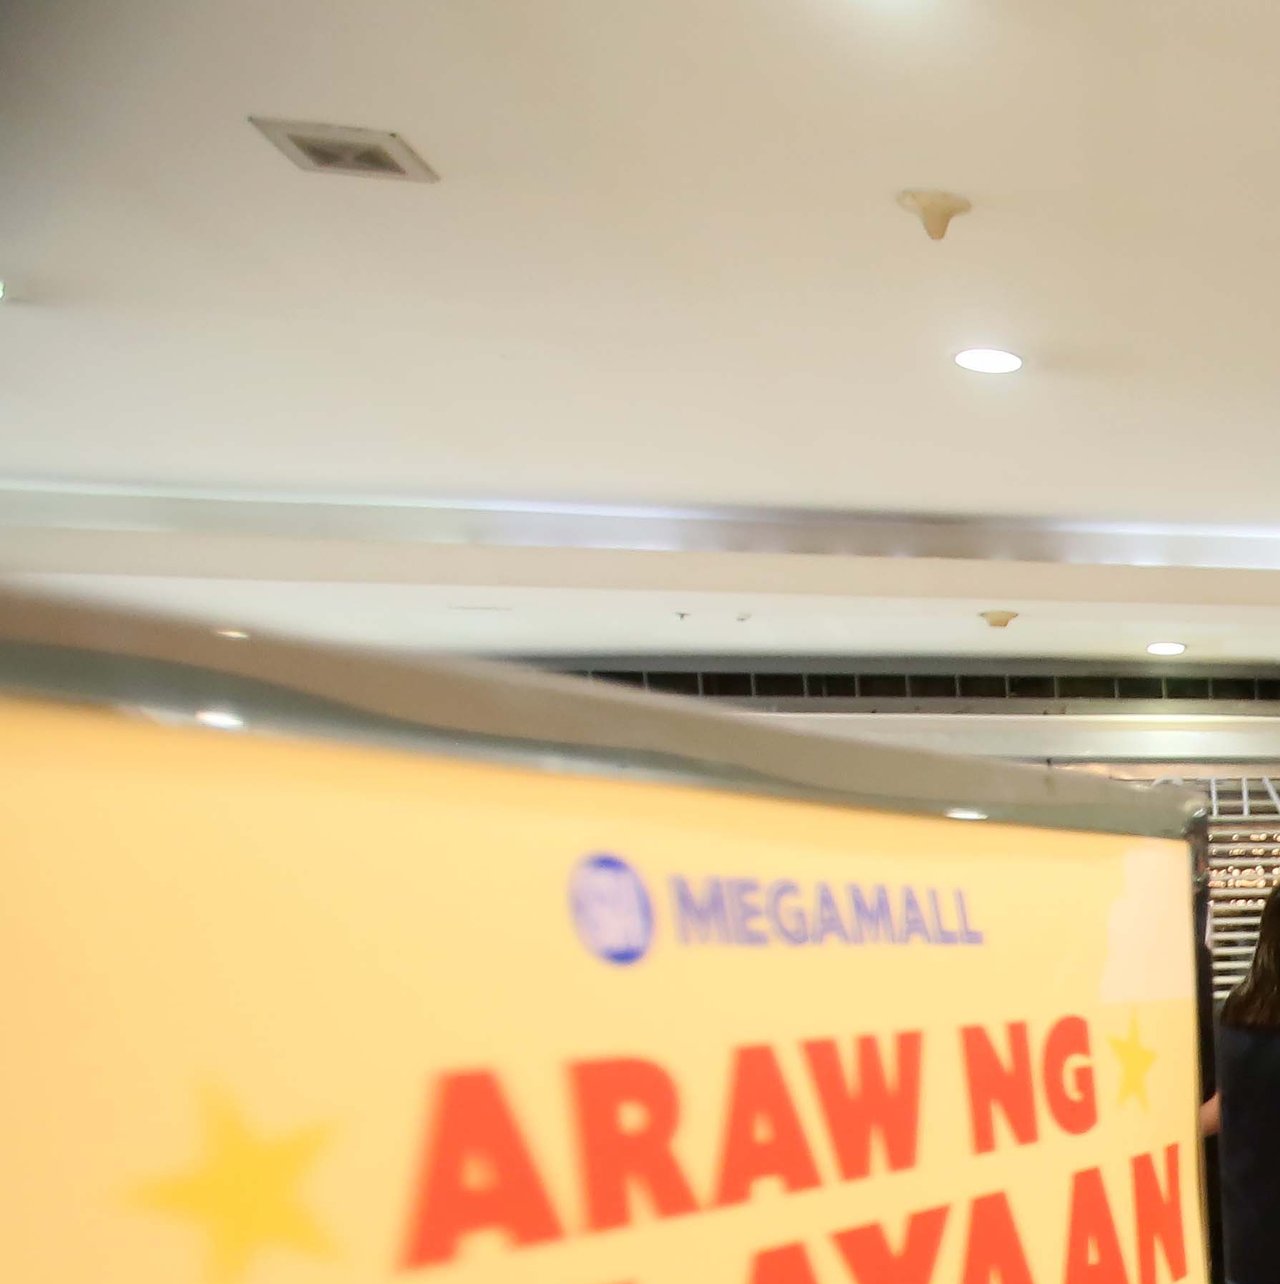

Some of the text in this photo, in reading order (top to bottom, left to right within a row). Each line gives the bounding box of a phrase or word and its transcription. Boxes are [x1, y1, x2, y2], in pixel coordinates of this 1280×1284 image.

[667, 872, 986, 950] MEGAMALL
[400, 1013, 1101, 1274] ARAW NG
